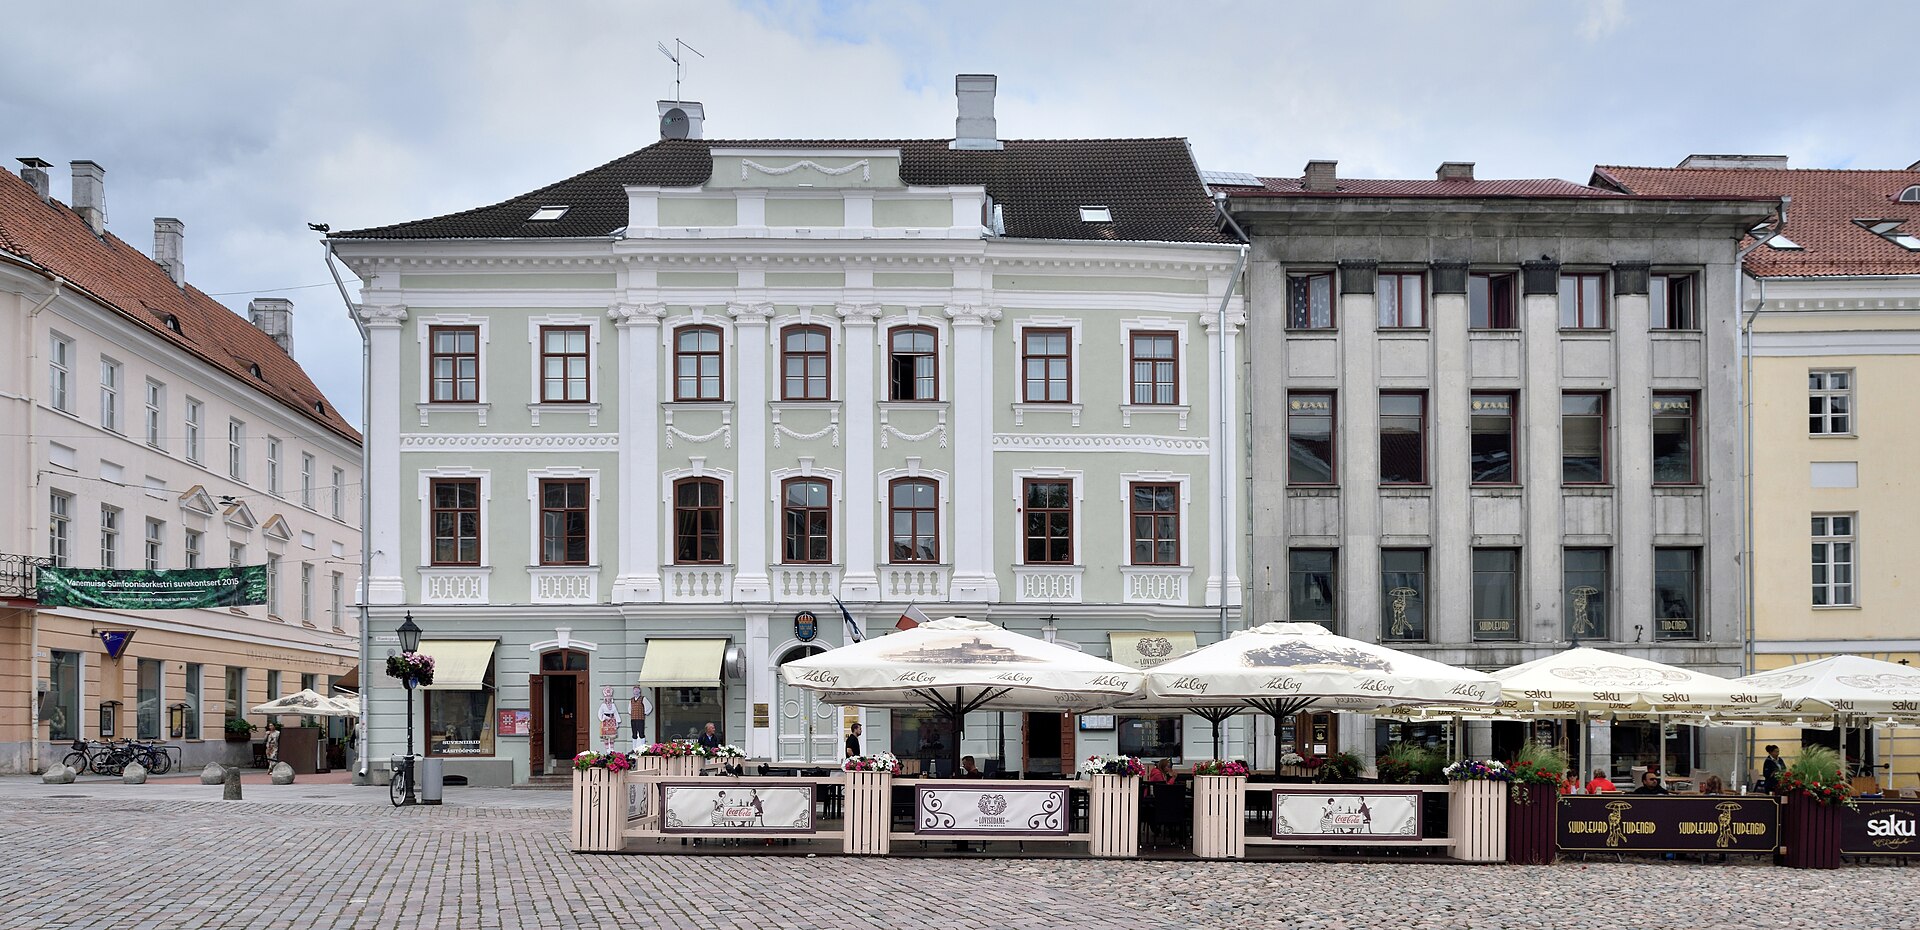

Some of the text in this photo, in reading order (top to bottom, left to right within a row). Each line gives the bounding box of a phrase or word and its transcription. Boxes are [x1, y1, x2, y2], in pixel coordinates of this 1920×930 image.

[66, 578, 239, 588] Vanemuise Sümfooniaorkestri suvekontsert 2015
[1479, 621, 1509, 631] SUUDLEVAD
[1524, 689, 1552, 699] saku
[1593, 691, 1620, 701] saku
[1662, 692, 1690, 702] saku
[1730, 692, 1758, 703] saku
[1830, 699, 1854, 711] aku
[1892, 700, 1918, 711] saku
[1568, 821, 1656, 834] SUUDLEVAD TUDENGID
[1678, 822, 1766, 835] SUUDLEVAD TUDENGID
[1867, 813, 1916, 836] saku
